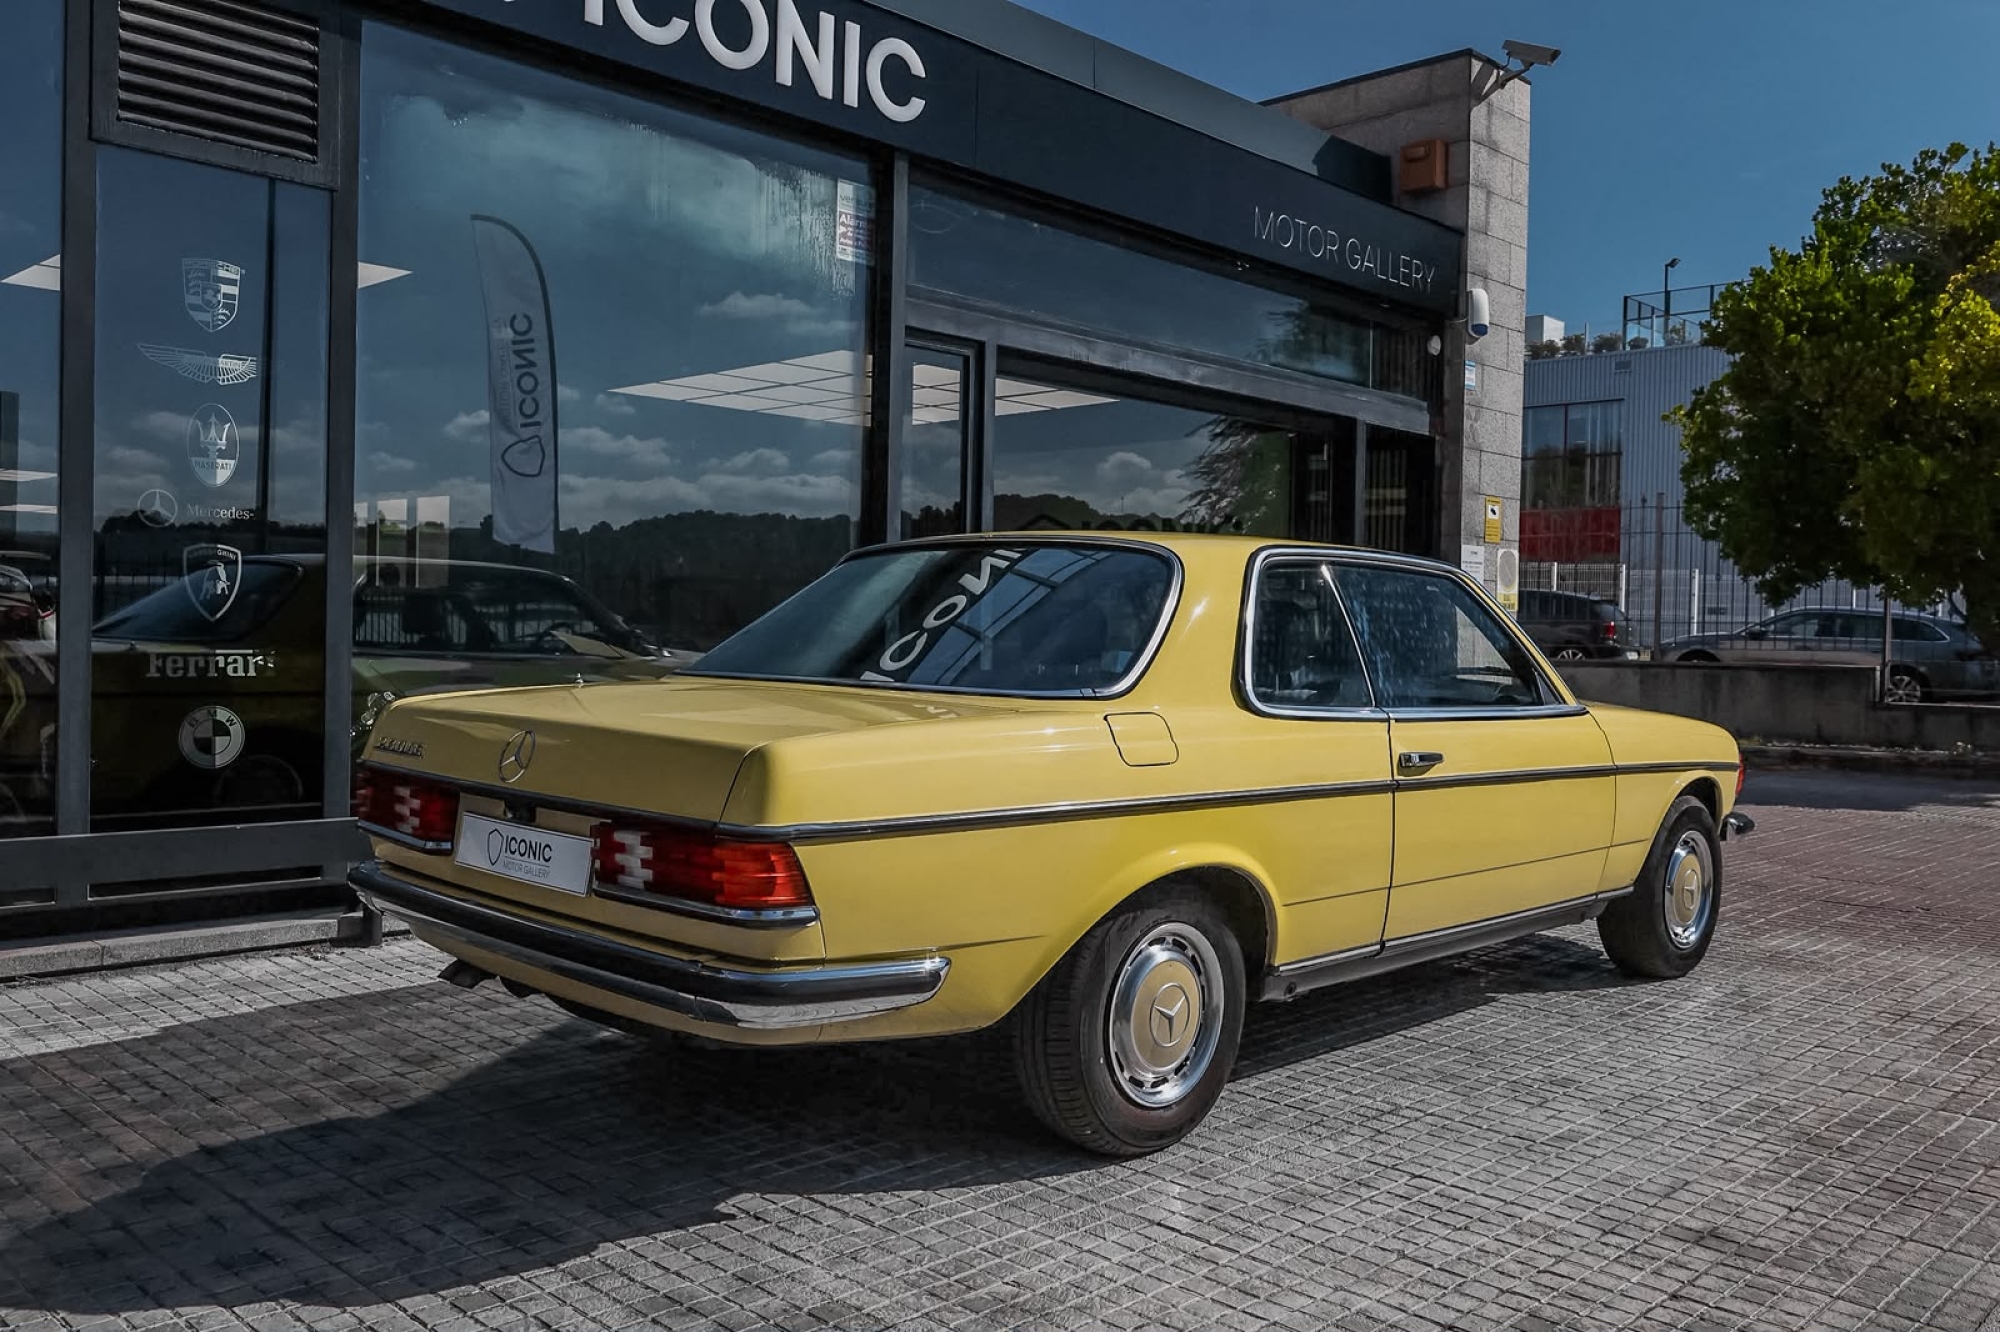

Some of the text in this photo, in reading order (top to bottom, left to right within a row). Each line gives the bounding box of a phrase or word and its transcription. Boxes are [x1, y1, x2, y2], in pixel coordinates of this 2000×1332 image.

[584, 0, 926, 122] CONIC
[1254, 206, 1436, 295] MOTOR GALLERY
[194, 460, 232, 472] MASERATI
[188, 709, 238, 728] BMW
[505, 835, 552, 862] ICONIC
[503, 860, 551, 879] MOTOR GALLERY
